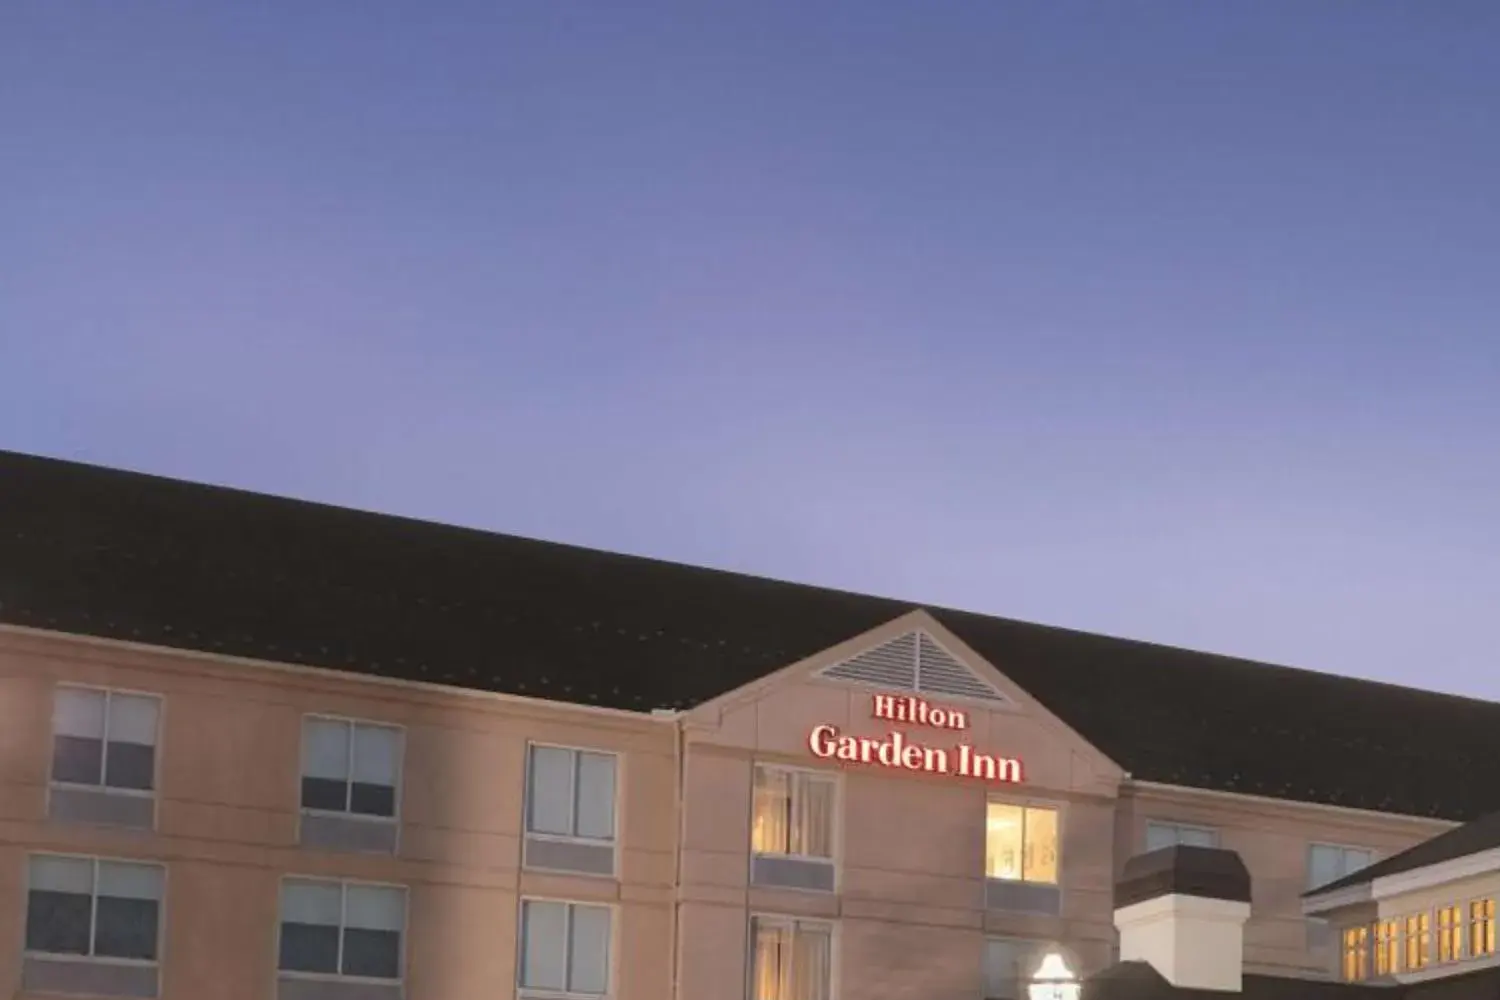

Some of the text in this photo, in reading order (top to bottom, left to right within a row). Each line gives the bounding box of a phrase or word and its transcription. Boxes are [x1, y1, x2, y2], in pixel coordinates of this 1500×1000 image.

[874, 695, 966, 729] Hilton
[809, 725, 1022, 782] Garden Inn
